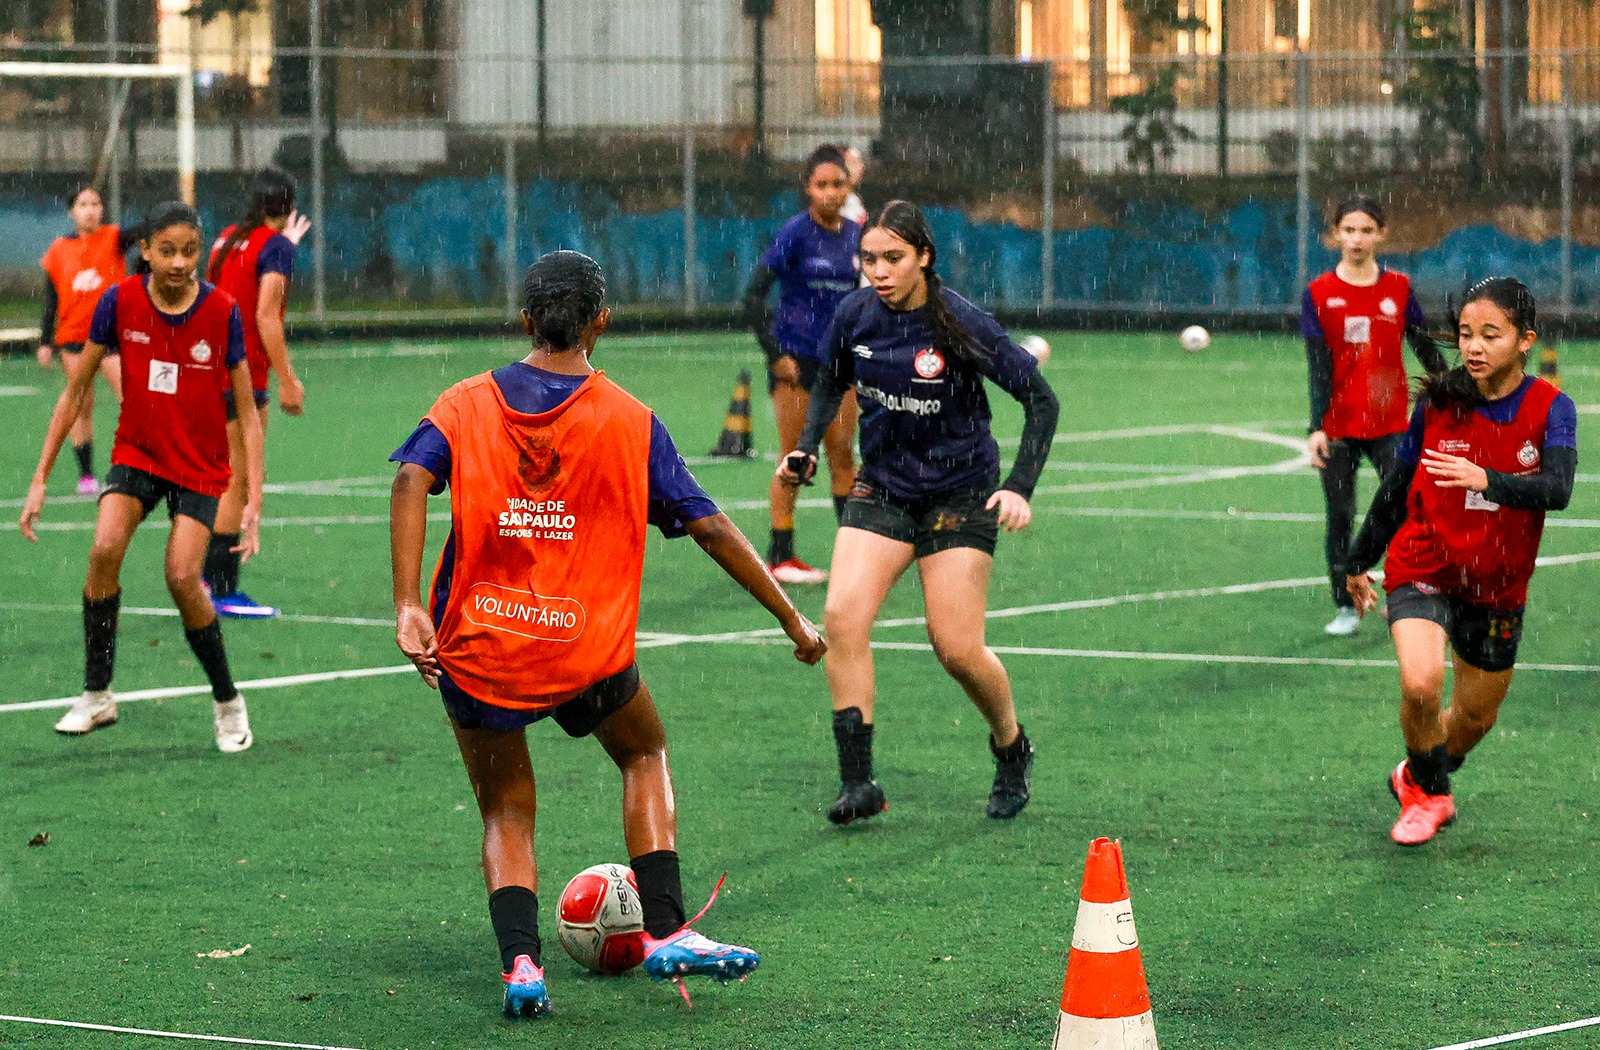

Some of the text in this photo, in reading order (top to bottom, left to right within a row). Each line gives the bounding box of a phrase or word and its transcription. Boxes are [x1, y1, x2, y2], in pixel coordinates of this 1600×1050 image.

[546, 500, 566, 512] DE
[522, 512, 576, 529] PAULO
[544, 530, 574, 541] LAZER
[475, 594, 577, 629] VOLUNTÁRIO
